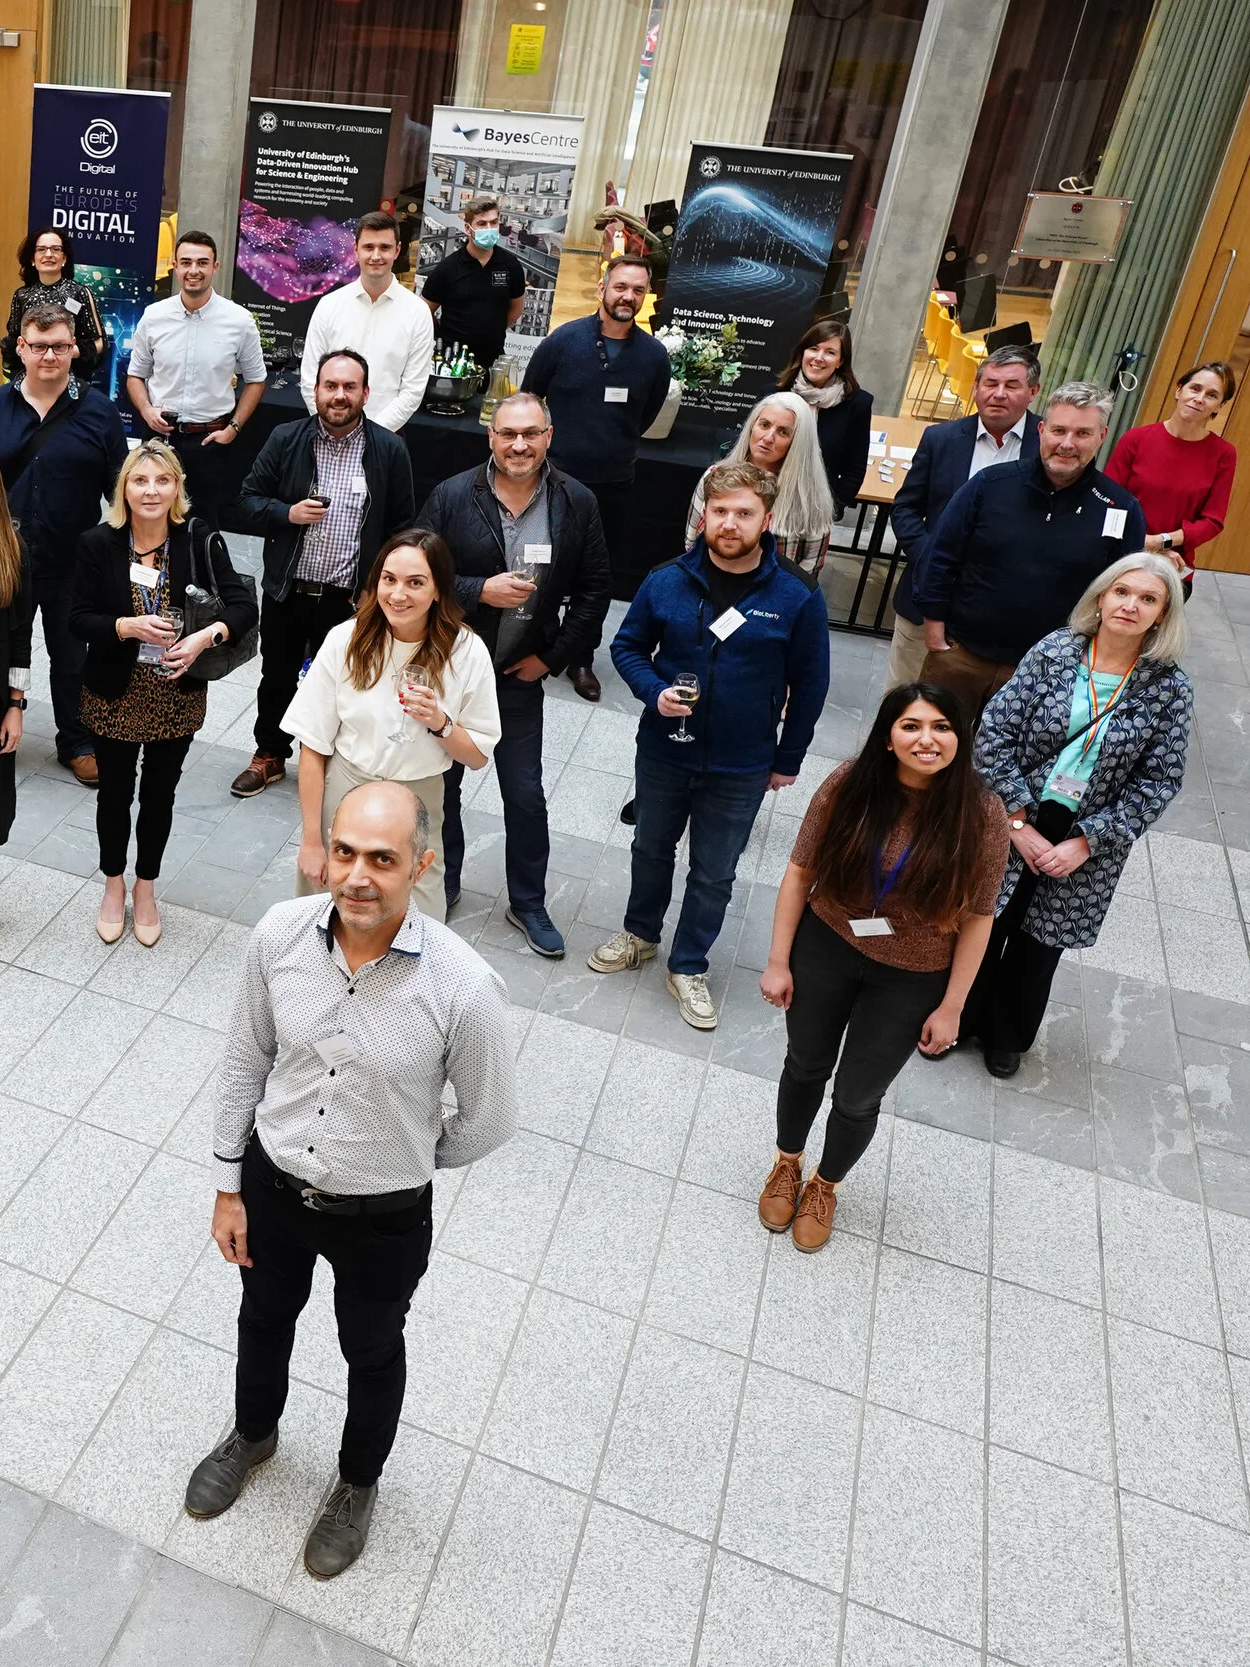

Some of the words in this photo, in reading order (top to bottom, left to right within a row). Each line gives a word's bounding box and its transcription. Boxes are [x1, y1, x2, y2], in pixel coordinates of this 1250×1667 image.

[296, 120, 336, 131] UNIVERSITY
[335, 125, 342, 133] of
[342, 125, 383, 135] EDINBURGH
[89, 131, 110, 144] eit
[484, 128, 579, 148] BayesCentre
[258, 147, 295, 159] University
[296, 150, 305, 159] of
[305, 151, 350, 163] Edinburgh's
[79, 162, 116, 174] Digital
[257, 157, 301, 169] Data-Driven
[301, 162, 342, 173] Innovation
[342, 166, 359, 174] Hub
[727, 164, 742, 172] THE
[743, 166, 787, 177] UNIVERSITY
[787, 170, 795, 179] of
[794, 171, 841, 182] EDINBURGH
[256, 167, 268, 175] for
[268, 169, 296, 178] Science
[296, 171, 303, 179] &
[303, 172, 349, 185] Engineering
[55, 185, 74, 194] THE
[80, 187, 119, 197] FUTURE
[330, 195, 353, 203] computing
[54, 193, 138, 212] EUROPE'S
[52, 208, 135, 235] DIGITAL
[68, 231, 135, 243] NOVATION
[673, 307, 692, 316] Data
[693, 309, 726, 321] Science,
[728, 314, 775, 327] Technology
[505, 342, 522, 350] tting
